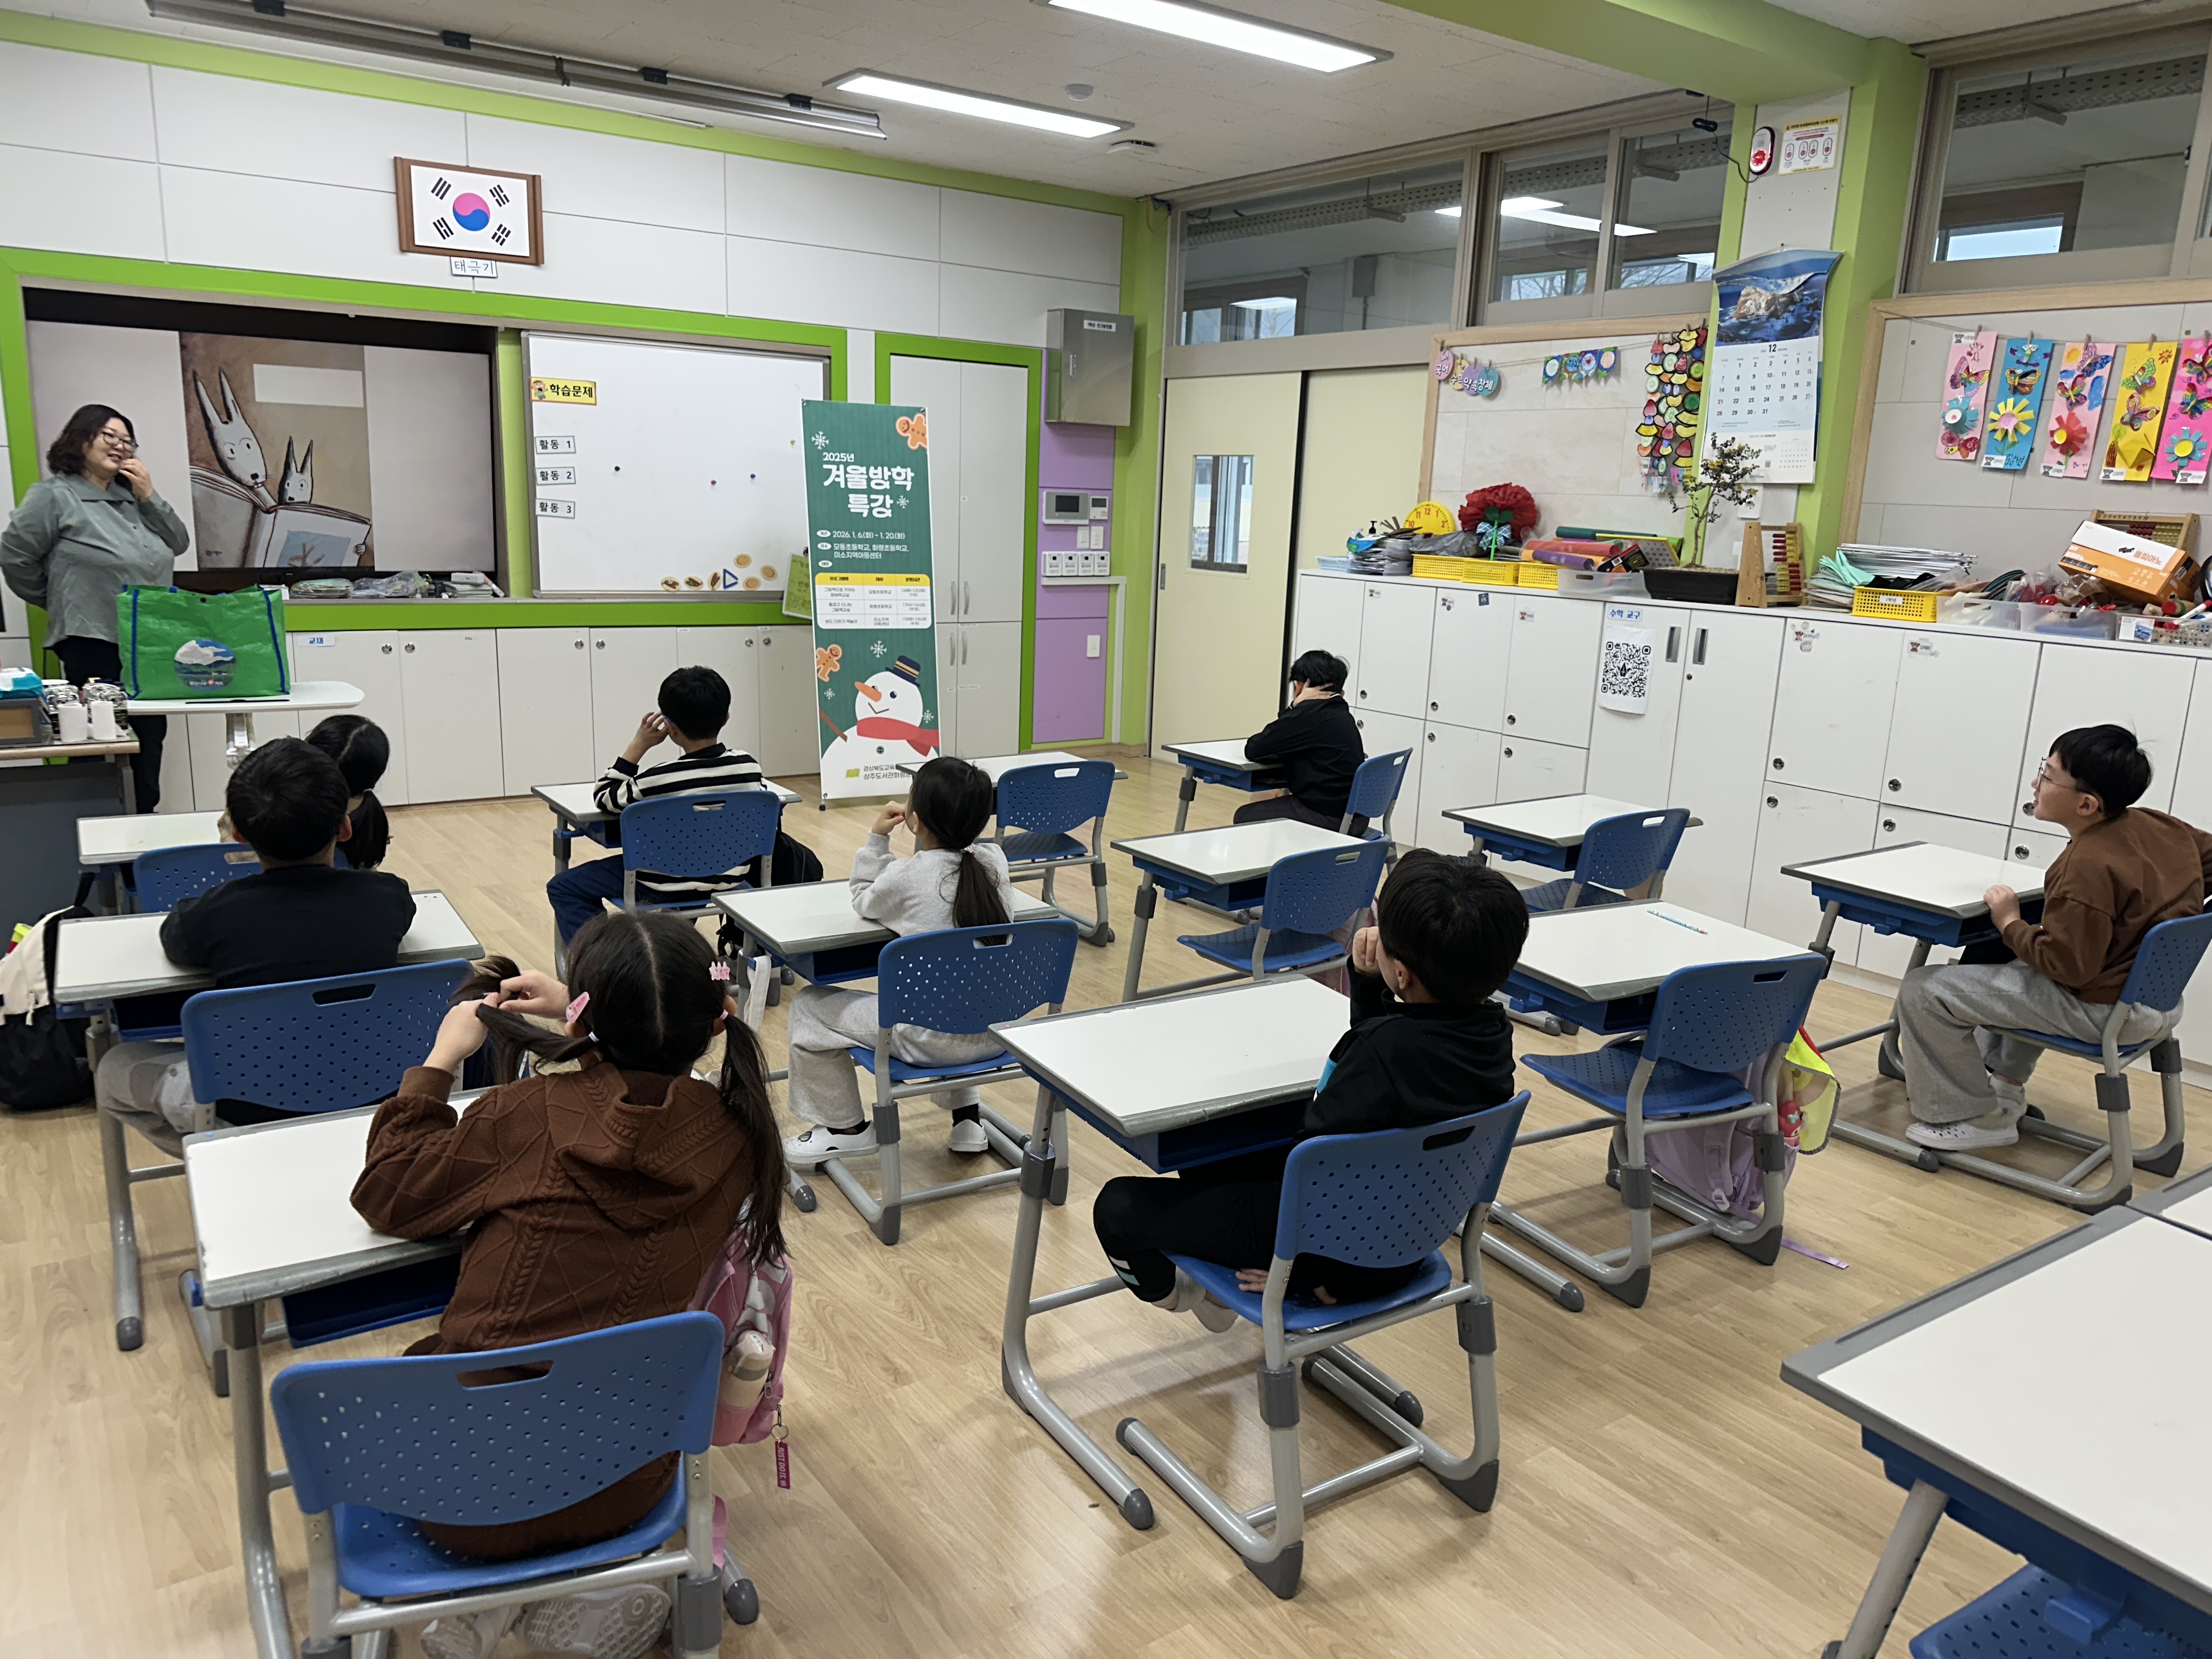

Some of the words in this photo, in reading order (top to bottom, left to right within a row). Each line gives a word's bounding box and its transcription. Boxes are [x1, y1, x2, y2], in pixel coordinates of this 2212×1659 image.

[454, 260, 494, 275] 태극기
[1769, 343, 1776, 352] 12
[1436, 364, 1449, 376] 국어
[549, 383, 593, 398] 학습문제
[1478, 378, 1494, 392] 창체
[539, 439, 559, 450] 활동
[567, 441, 571, 449] 1
[822, 452, 855, 462] 2025년
[540, 471, 560, 481] 활동
[566, 471, 572, 479] 2
[822, 464, 915, 491] 겨울방학
[539, 501, 559, 513] 활동
[566, 505, 571, 514] 3
[848, 494, 894, 518] 특강
[1610, 609, 1623, 618] 수학
[1626, 611, 1640, 619] 교구
[777, 1447, 786, 1463] JUST
[778, 1462, 786, 1472] DO
